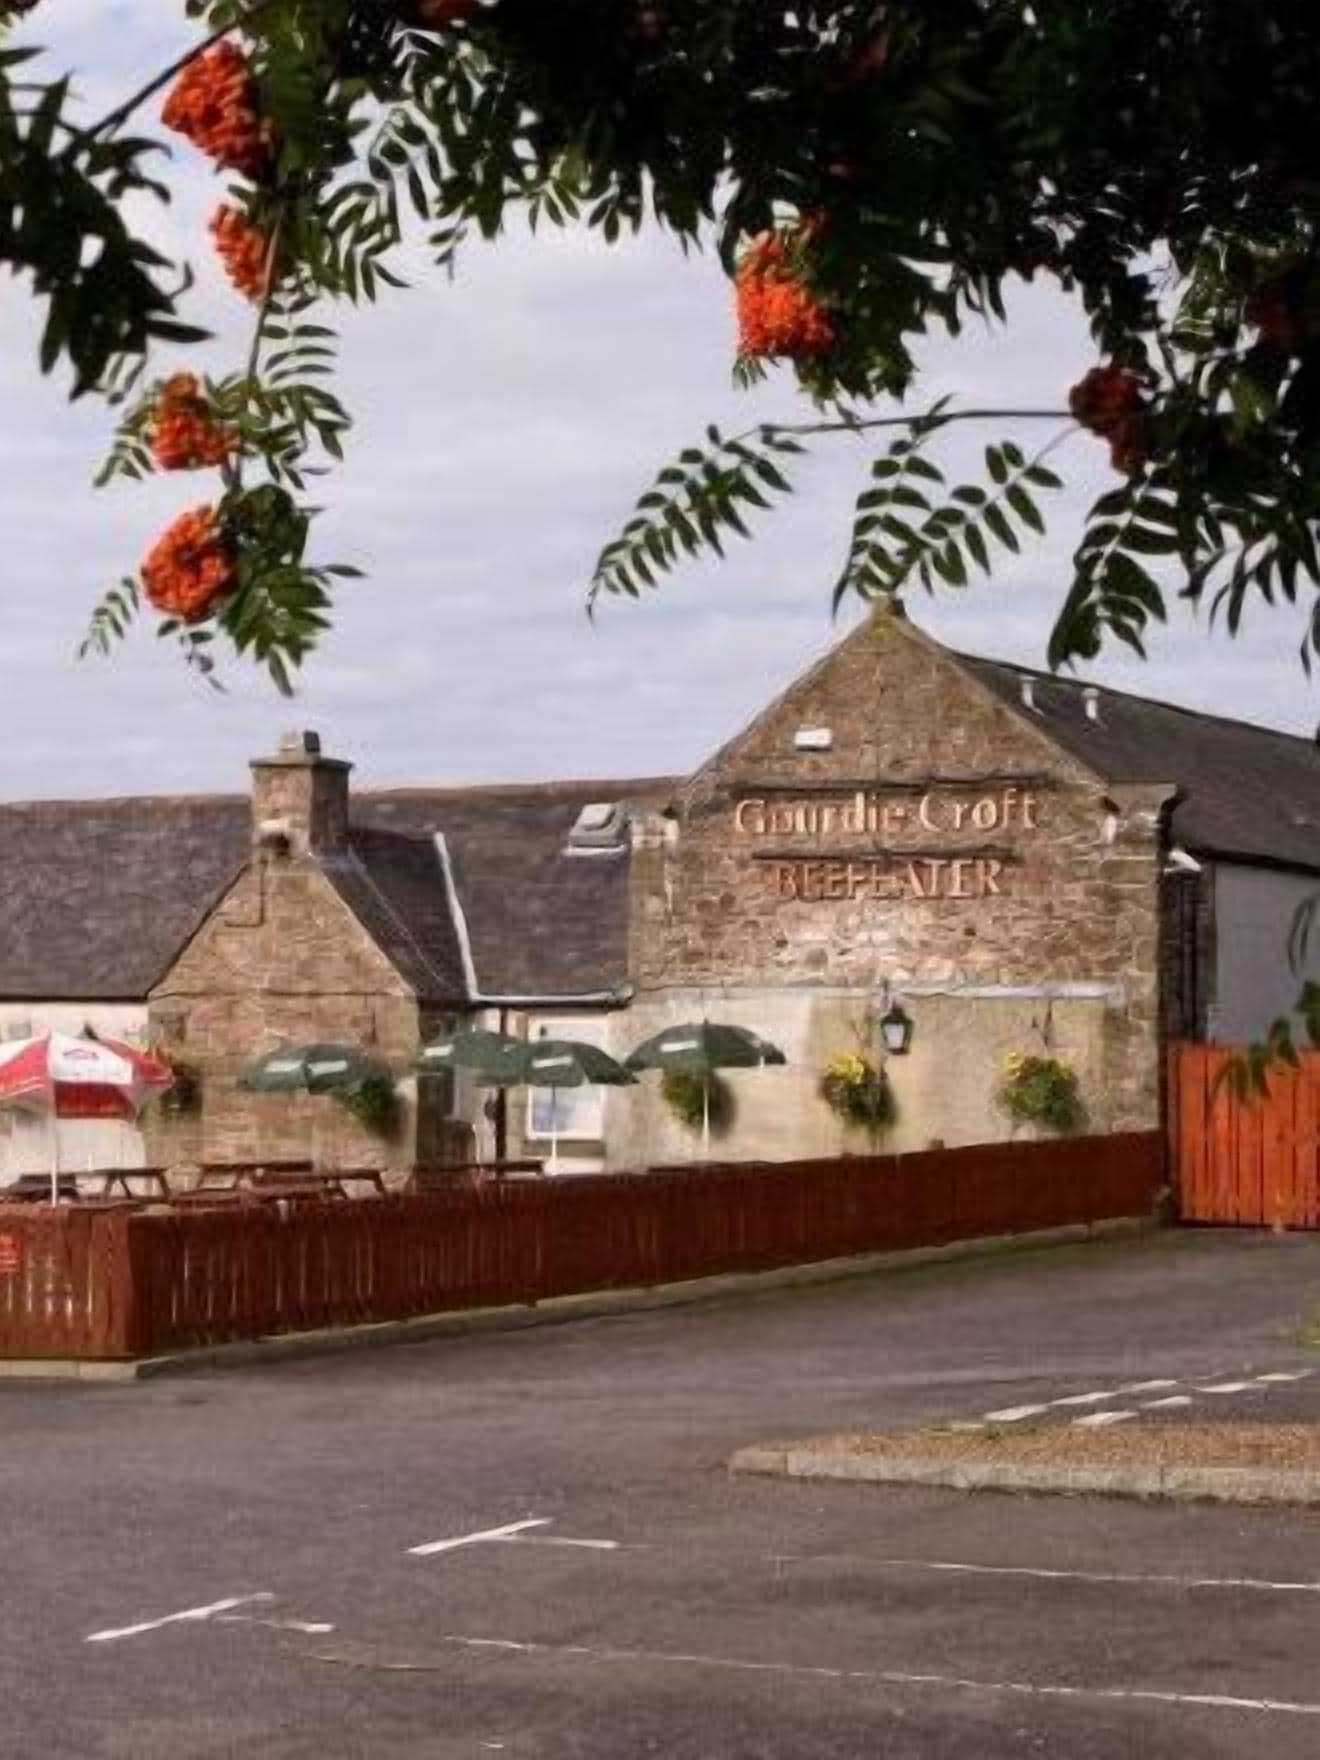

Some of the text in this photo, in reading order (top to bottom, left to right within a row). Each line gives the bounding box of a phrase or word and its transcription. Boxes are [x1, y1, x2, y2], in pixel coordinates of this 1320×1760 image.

[735, 788, 1037, 833] Gourdie Croft
[776, 859, 1002, 898] BEEFEATER
